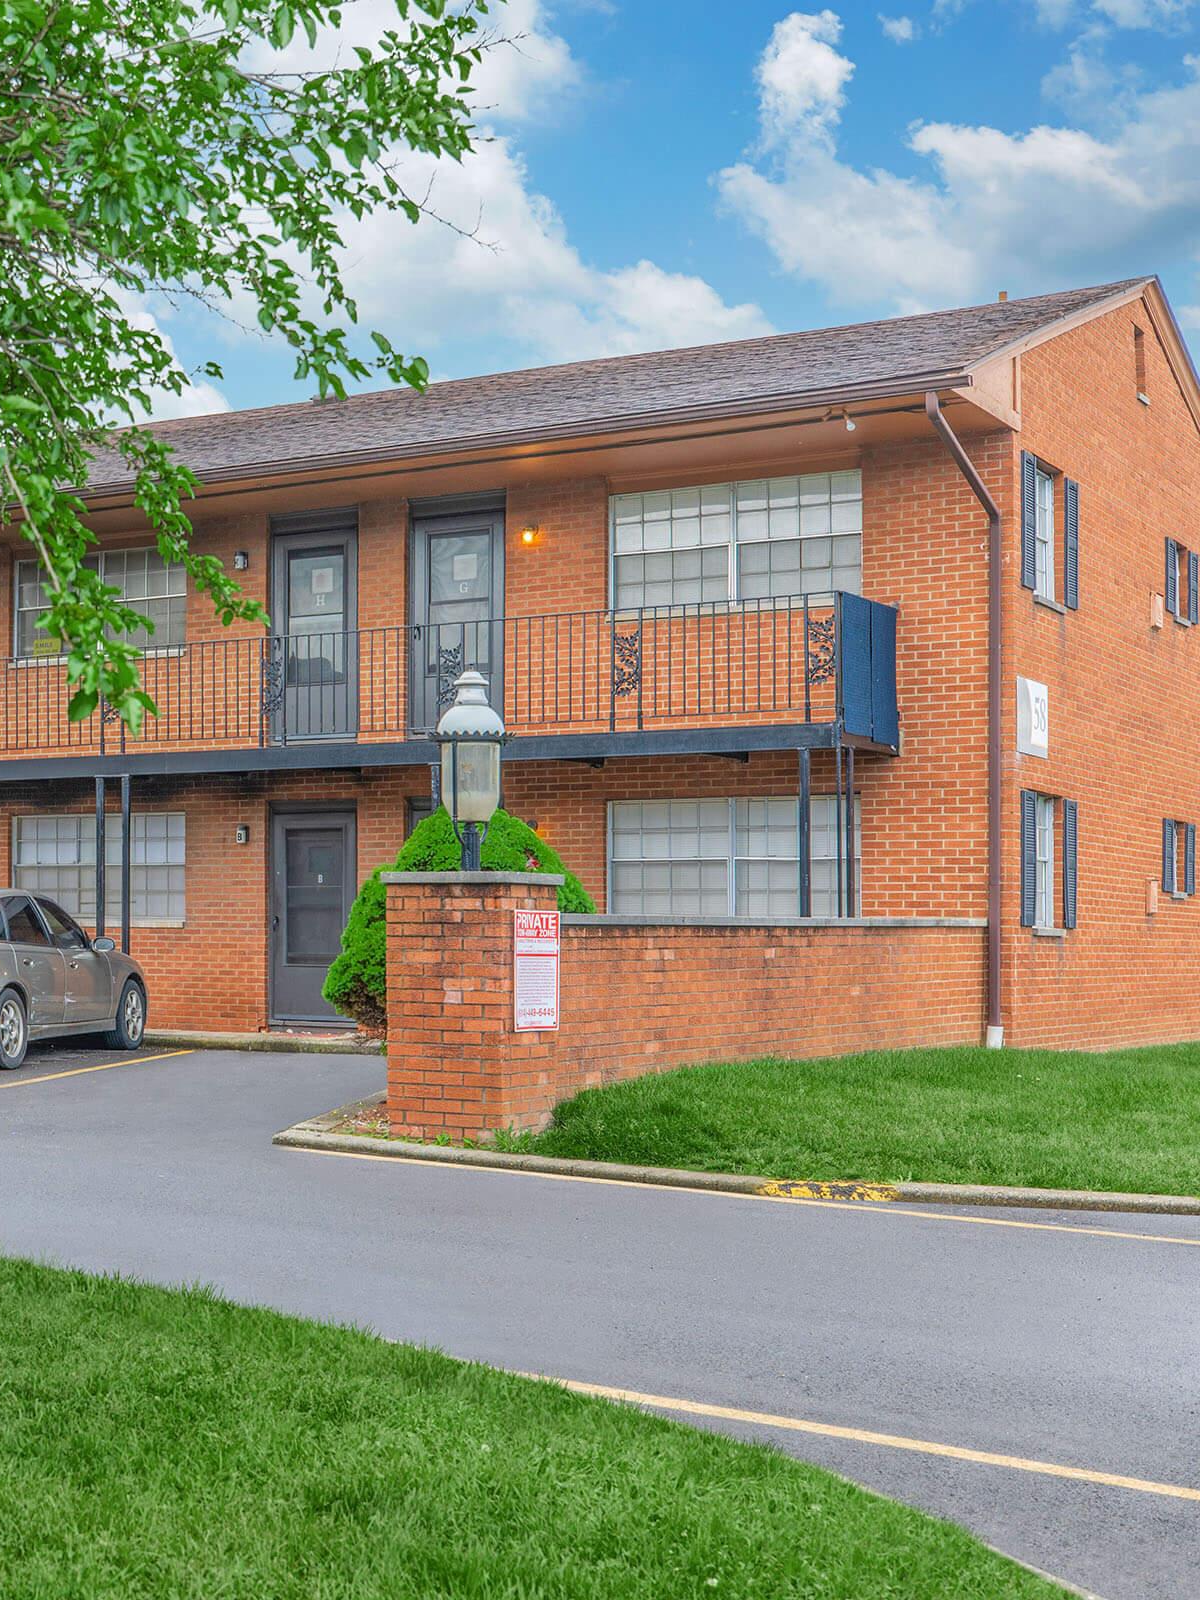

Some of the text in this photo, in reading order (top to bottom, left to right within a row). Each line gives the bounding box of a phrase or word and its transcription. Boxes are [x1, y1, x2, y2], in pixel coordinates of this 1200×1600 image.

[460, 583, 469, 593] G
[315, 594, 326, 607] H
[1033, 697, 1046, 732] 58
[517, 913, 557, 929] PRIVATE
[539, 929, 557, 938] ZONE
